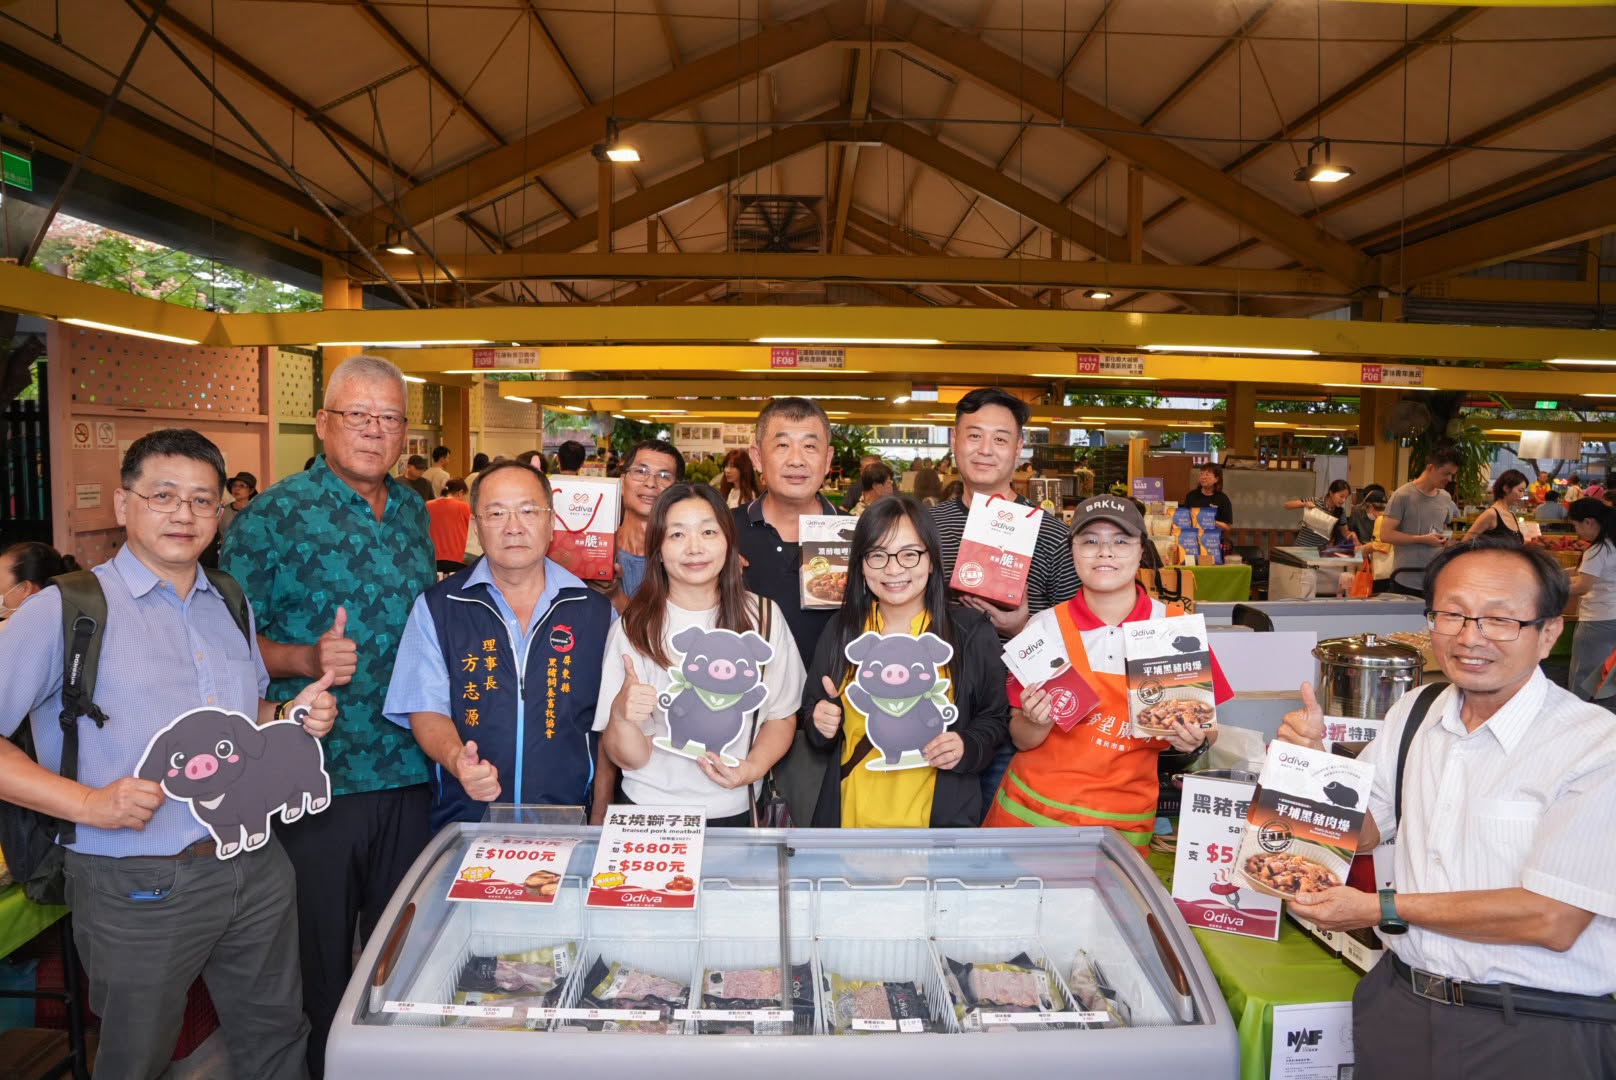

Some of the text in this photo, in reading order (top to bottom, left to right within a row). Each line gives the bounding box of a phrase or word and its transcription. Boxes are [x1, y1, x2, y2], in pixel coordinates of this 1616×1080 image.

[1079, 363, 1096, 371] F07
[1363, 373, 1379, 381] F06
[991, 520, 1015, 532] Odiva
[1018, 638, 1045, 659] Odiva
[482, 638, 499, 691] 理事長
[461, 653, 480, 727] 方志源
[1279, 752, 1310, 768] Odiva
[1192, 793, 1249, 819] 黑豬香
[610, 814, 701, 827] 紅燒獅子頭
[1228, 826, 1244, 834] sa
[486, 848, 556, 861] $1000元
[623, 842, 687, 854] $680元
[1188, 841, 1199, 861] 一支
[619, 860, 685, 872] $580元
[485, 886, 523, 895] Odiva
[621, 893, 662, 902] Odiva
[1203, 910, 1244, 927] Odiva
